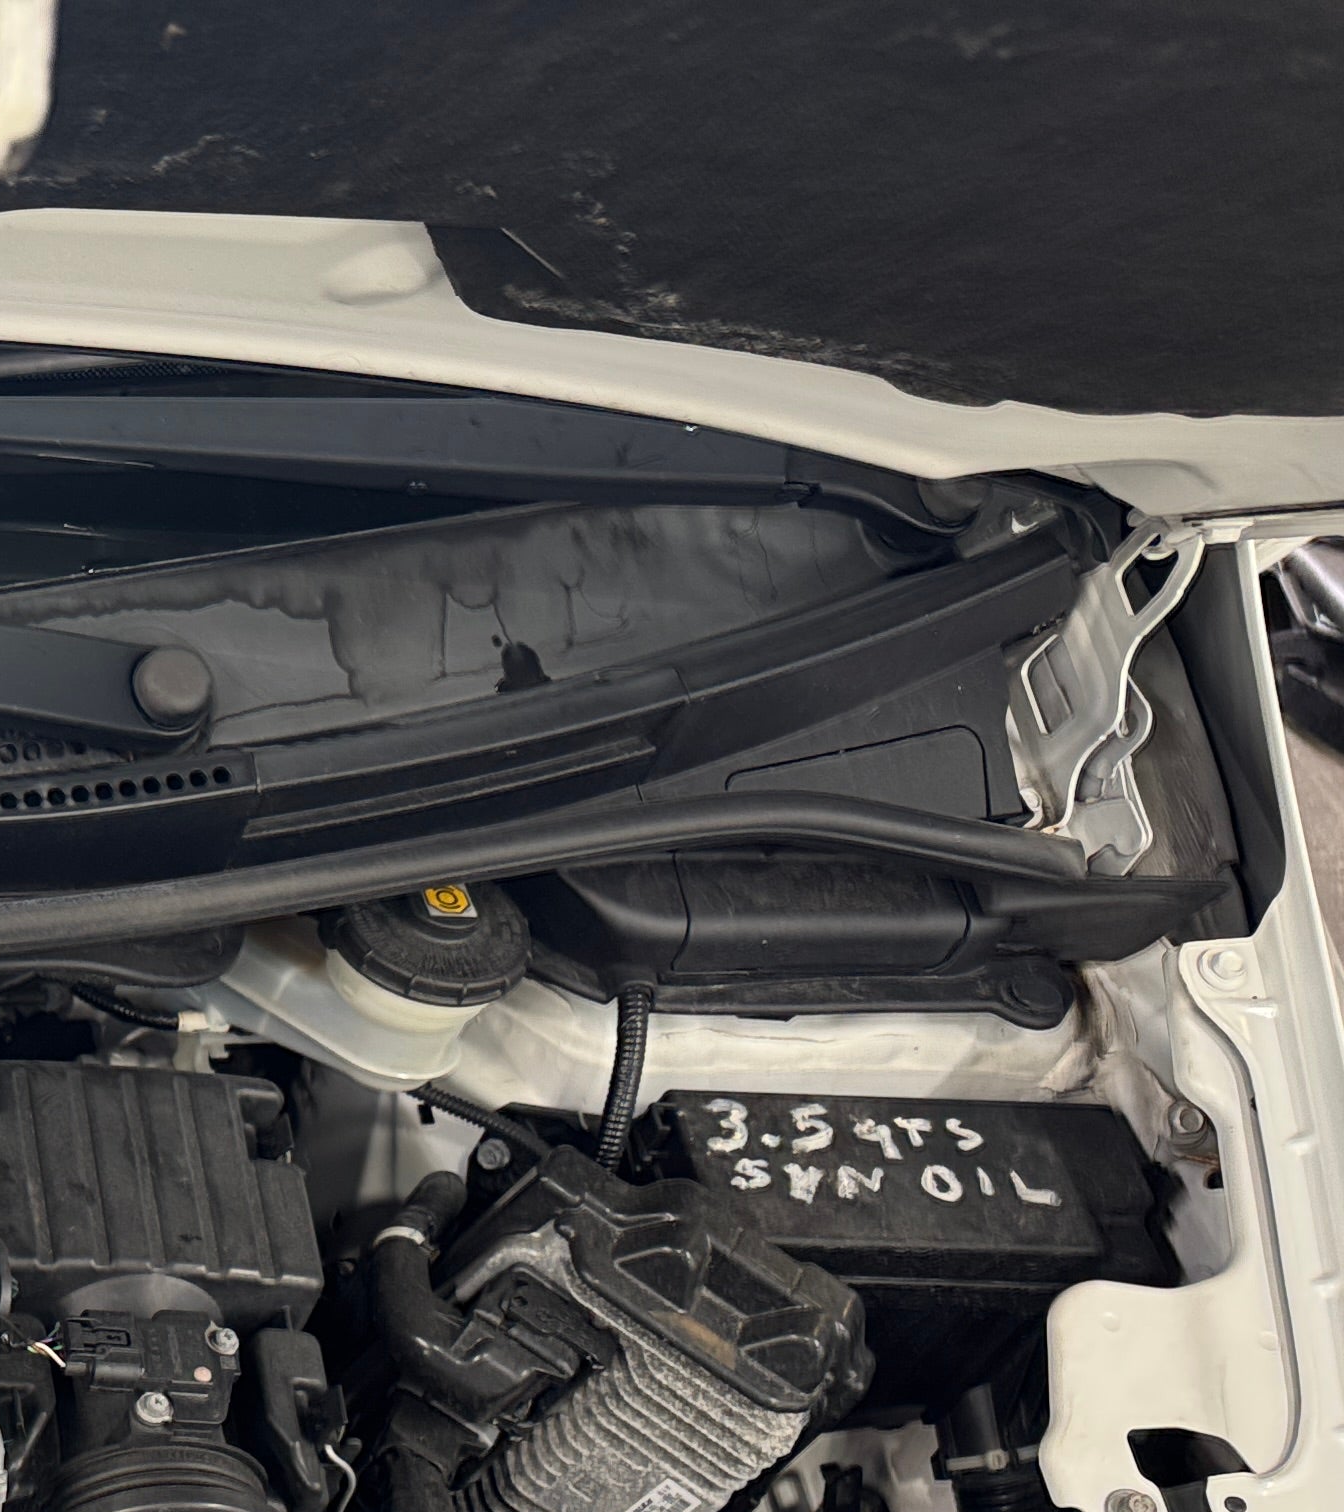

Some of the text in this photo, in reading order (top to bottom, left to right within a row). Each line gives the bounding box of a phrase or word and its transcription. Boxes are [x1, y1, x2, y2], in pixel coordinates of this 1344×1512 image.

[706, 1098, 834, 1155] 3.5
[730, 1157, 1063, 1207] SYN OIL
